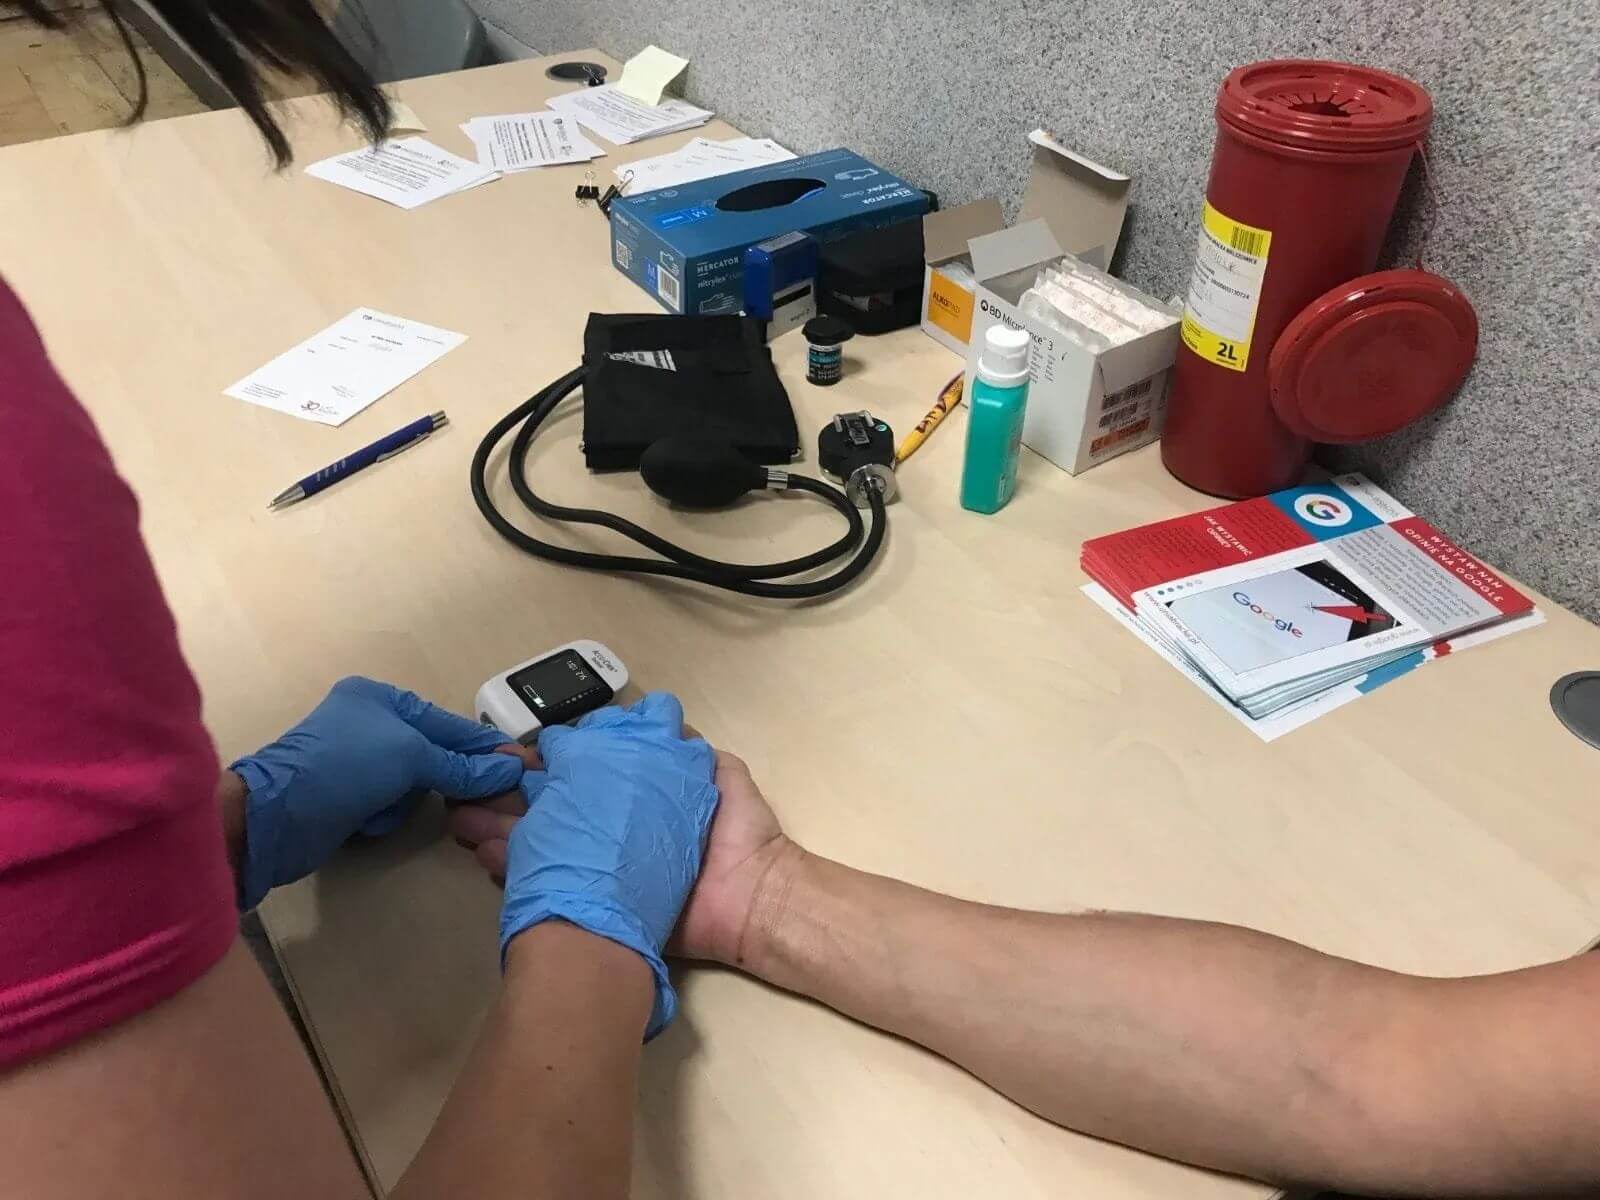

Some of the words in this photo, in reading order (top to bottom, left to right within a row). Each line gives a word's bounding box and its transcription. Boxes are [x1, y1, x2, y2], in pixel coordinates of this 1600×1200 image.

[697, 256, 739, 274] MERCATOR
[989, 305, 1002, 319] BD
[1047, 341, 1054, 351] 3
[1216, 342, 1238, 361] 2L
[1431, 535, 1478, 570] WYSTAW
[1478, 571, 1503, 589] NAM
[1439, 554, 1454, 567] NA
[1455, 566, 1504, 603] GOOGLE
[1233, 591, 1304, 639] Google
